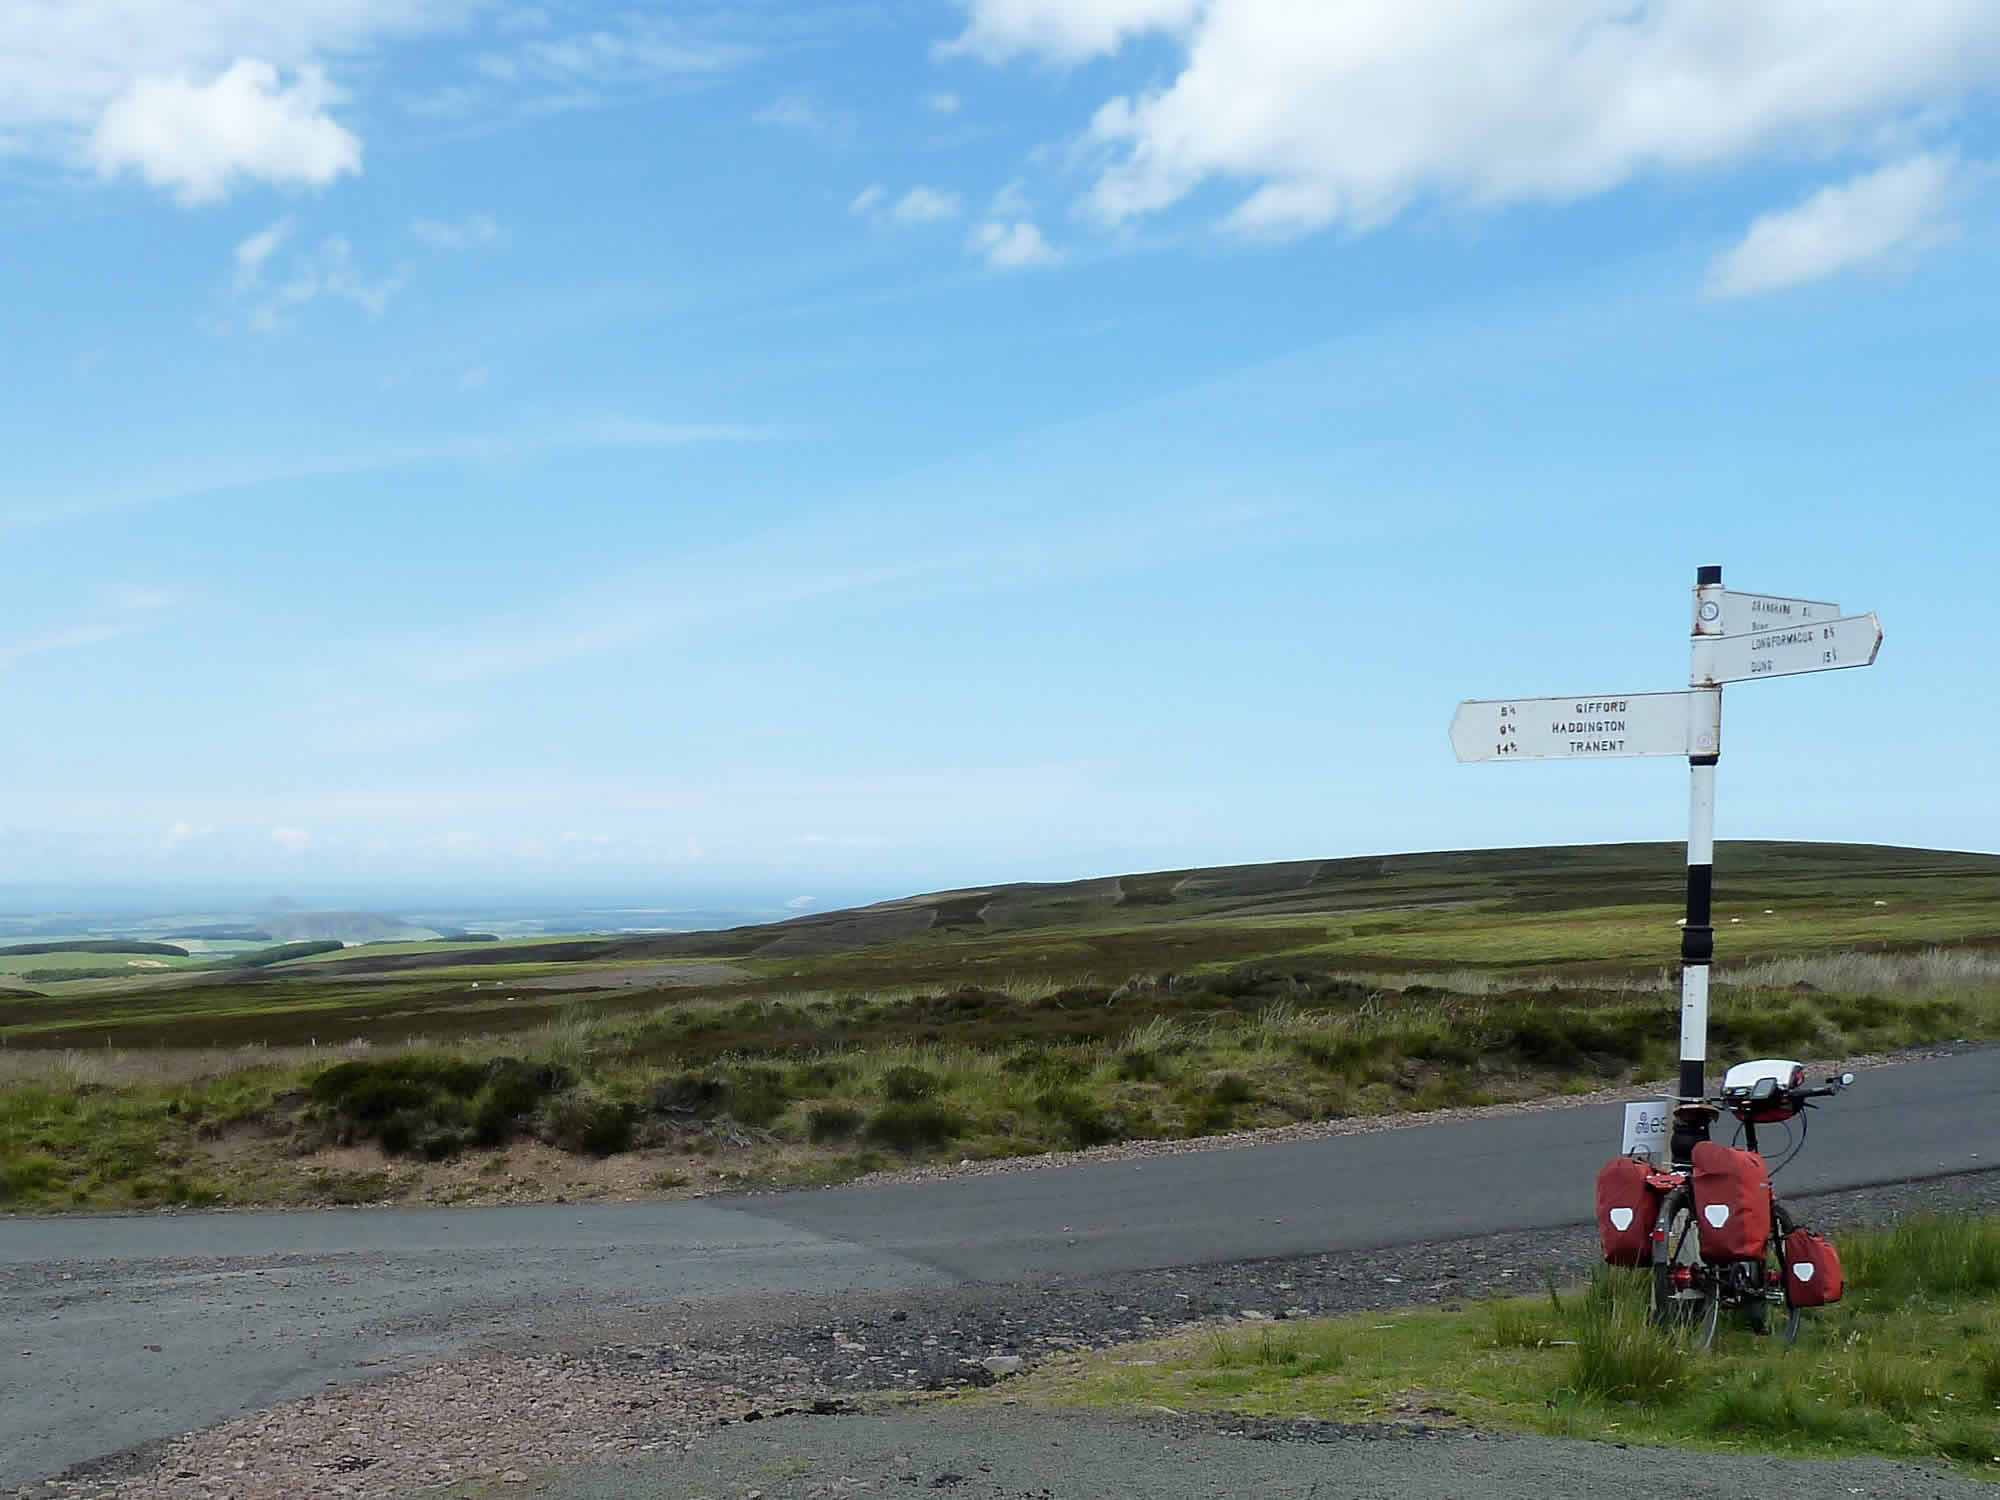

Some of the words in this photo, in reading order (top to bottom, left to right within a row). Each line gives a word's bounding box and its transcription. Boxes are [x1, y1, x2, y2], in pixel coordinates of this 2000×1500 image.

[1575, 701, 1626, 713] GIFFORD
[1552, 720, 1625, 734] HADDINGTON
[1569, 740, 1625, 753] TRANENT
